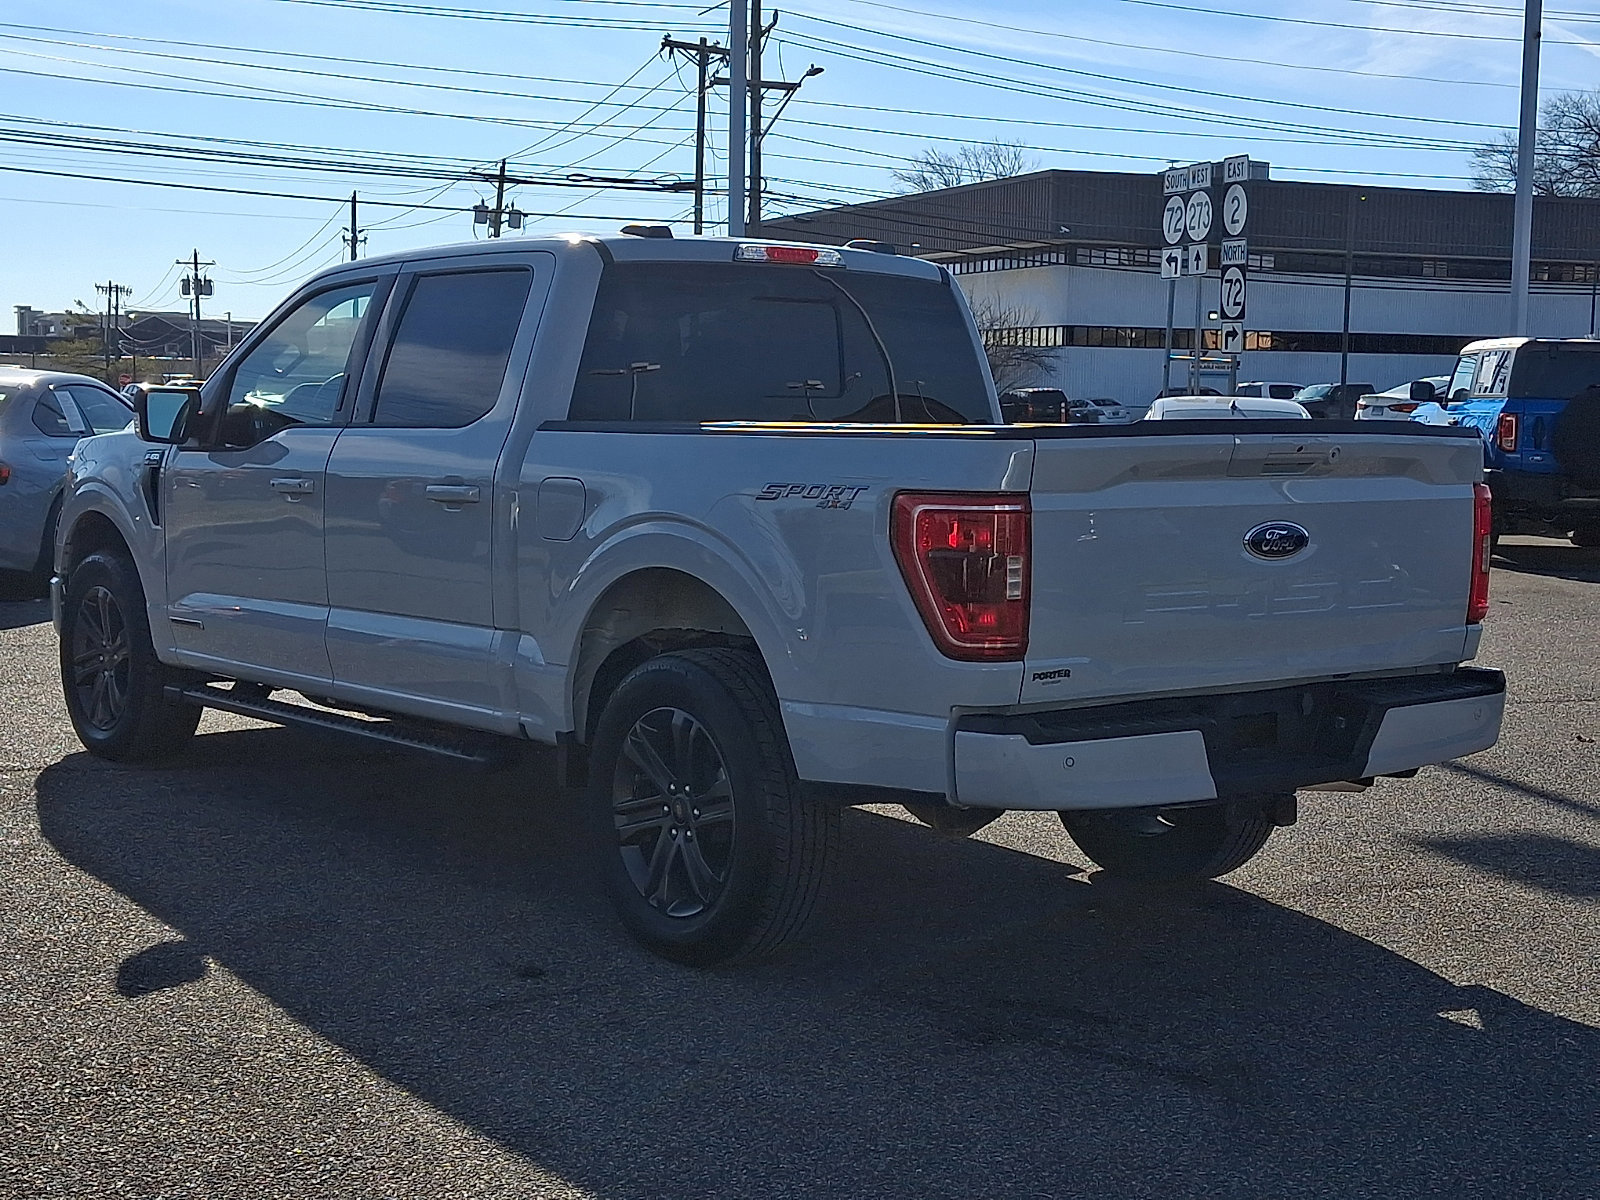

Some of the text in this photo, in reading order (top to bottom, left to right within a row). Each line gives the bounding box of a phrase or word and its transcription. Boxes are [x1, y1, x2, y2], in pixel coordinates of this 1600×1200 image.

[1191, 167, 1209, 184] WEST
[1227, 161, 1245, 179] EAST
[1165, 173, 1187, 190] SOUTH
[1166, 205, 1183, 234] 72
[1188, 200, 1210, 231] 273
[1230, 195, 1241, 225] 2
[1222, 244, 1246, 262] NORTH
[1224, 277, 1243, 307] 72
[755, 482, 870, 501] SPORT
[1261, 529, 1297, 552] Ford
[1031, 668, 1072, 682] PORTER
